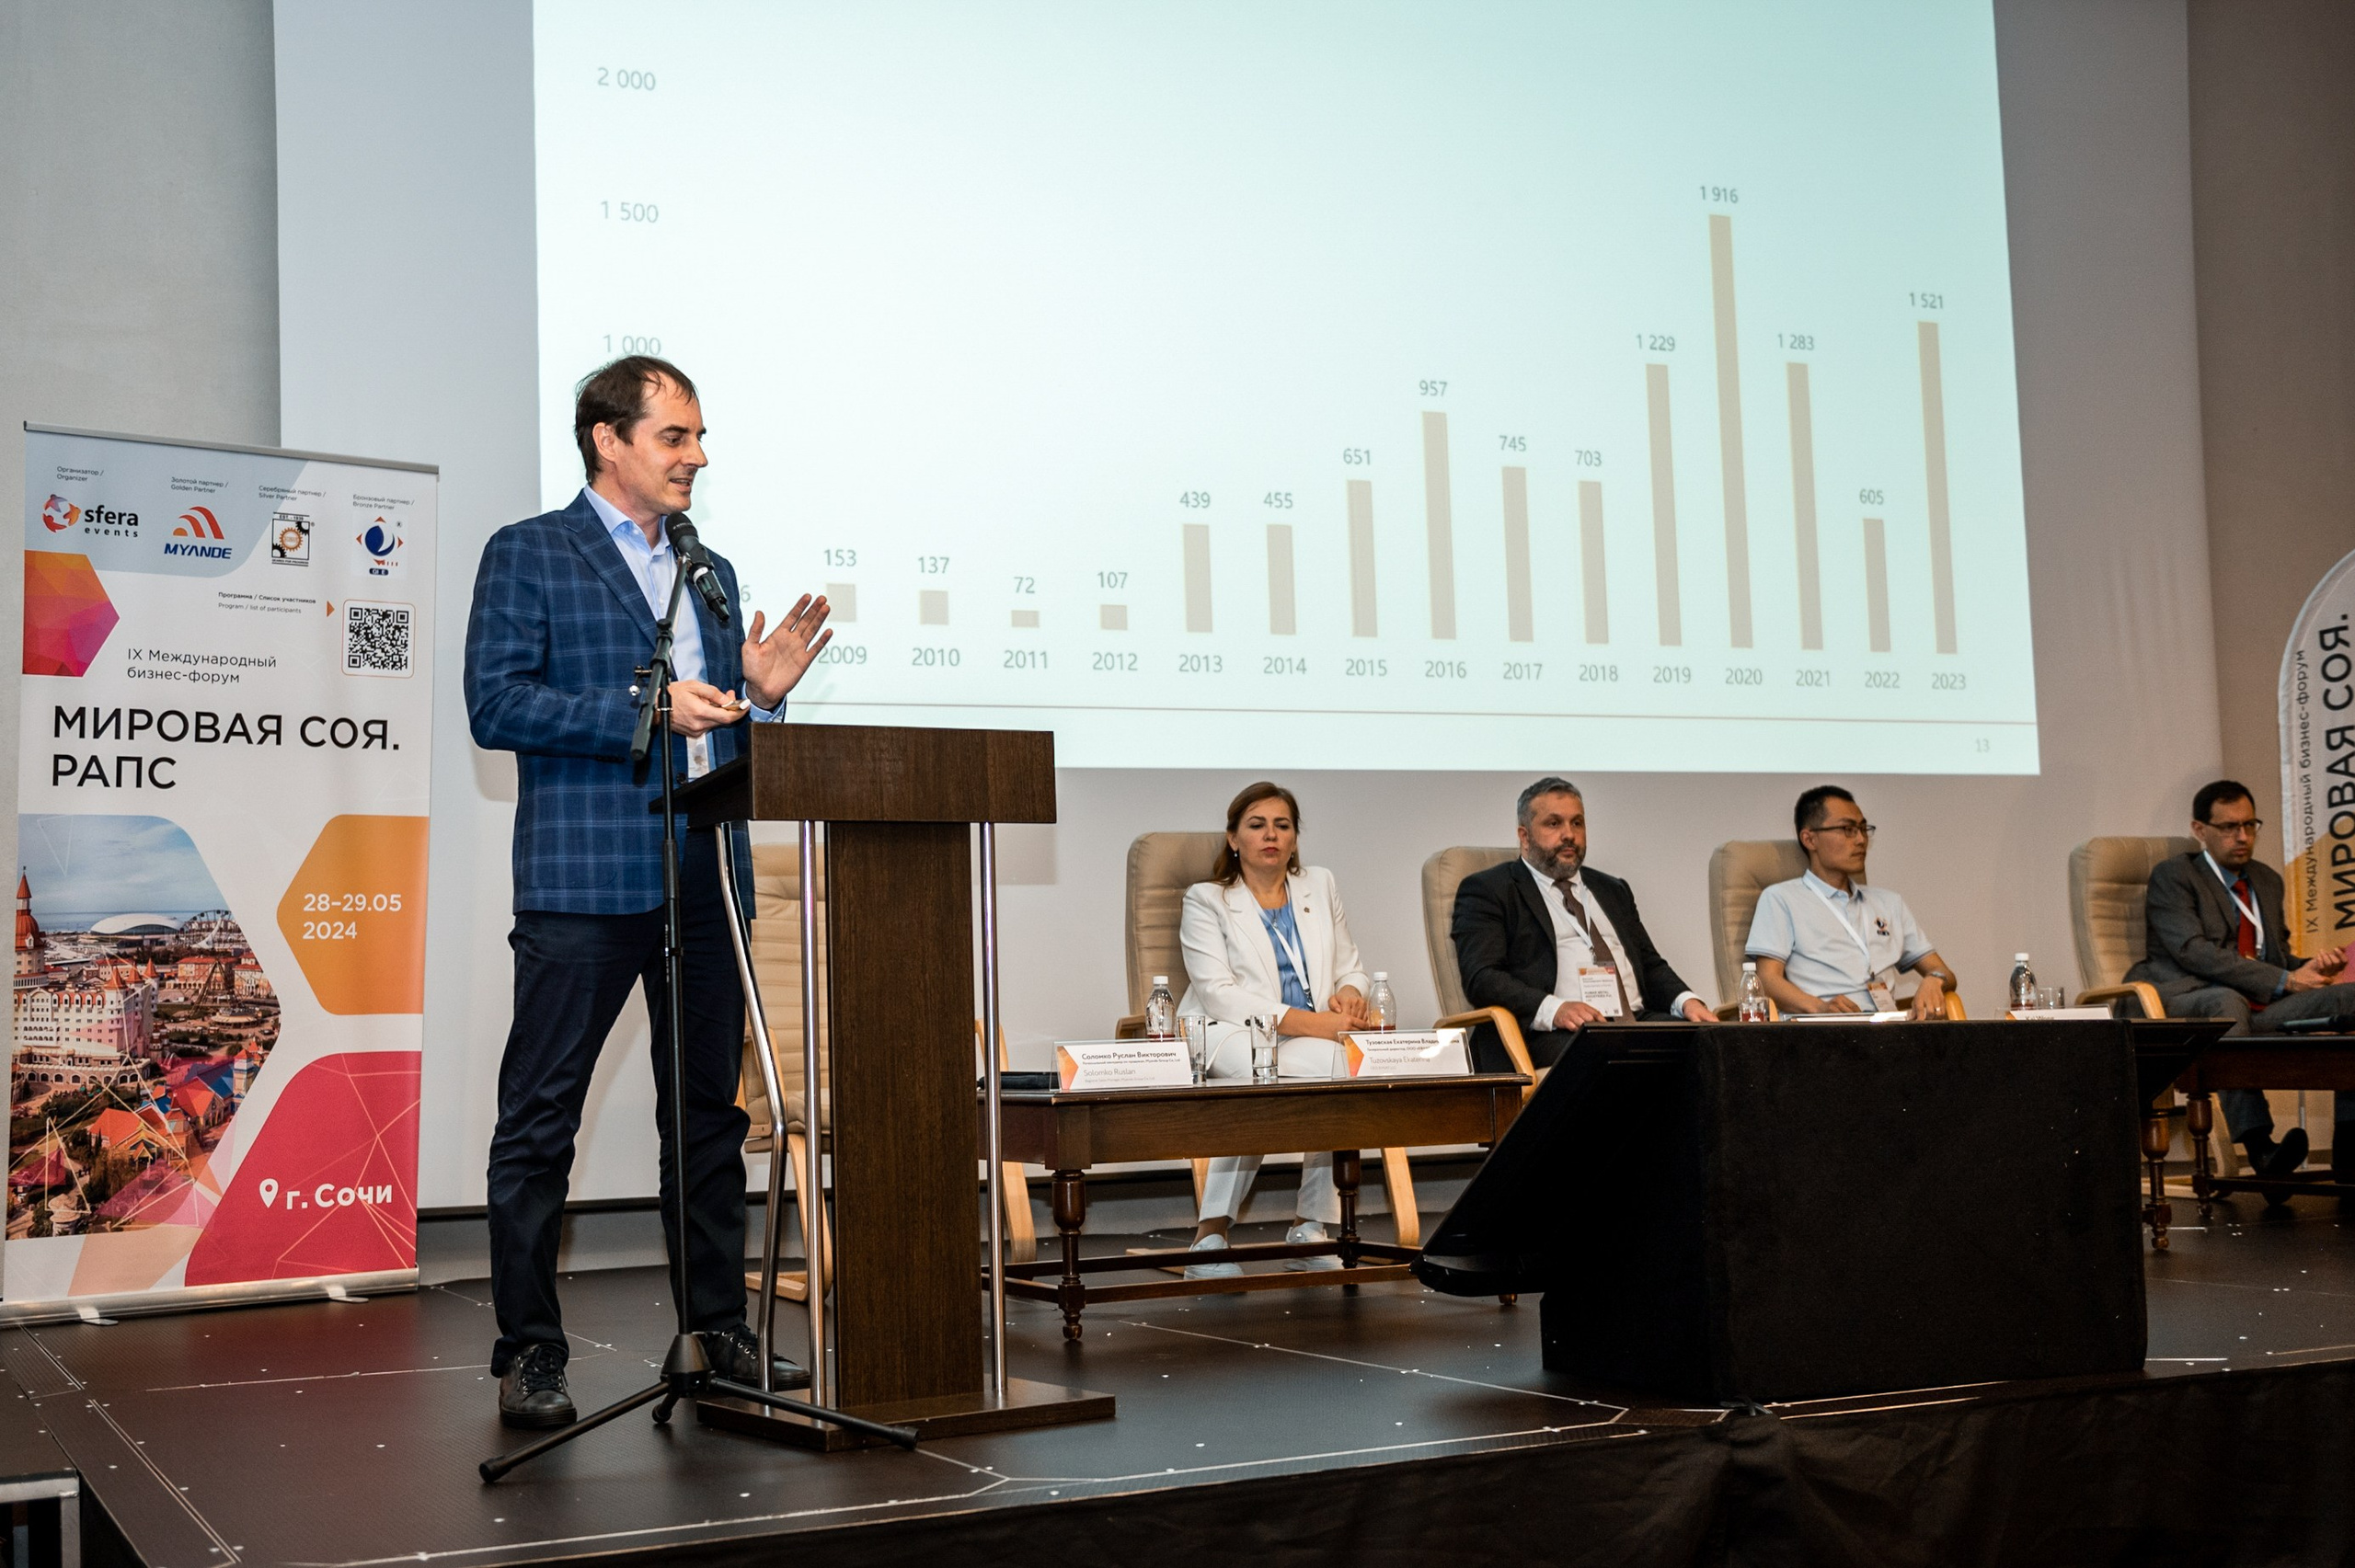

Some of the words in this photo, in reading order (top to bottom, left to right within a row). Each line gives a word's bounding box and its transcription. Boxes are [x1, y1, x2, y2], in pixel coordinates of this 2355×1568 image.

[617, 69, 656, 91] 000
[621, 201, 659, 223] 500
[622, 336, 661, 356] 000
[1419, 380, 1448, 396] 957
[1499, 435, 1526, 452] 745
[1343, 448, 1371, 465] 651
[1575, 450, 1603, 467] 703
[171, 476, 197, 485] Золотой
[1179, 491, 1211, 509] 439
[1263, 492, 1293, 509] 455
[1859, 488, 1884, 505] 605
[85, 505, 138, 526] sfera
[85, 527, 138, 538] events
[164, 544, 232, 559] MYANDE
[824, 549, 856, 567] 153
[918, 556, 949, 574] 137
[1014, 577, 1035, 594] 72
[1097, 571, 1128, 589] 107
[218, 591, 253, 600] Программа
[258, 594, 281, 602] Список
[218, 602, 245, 611] Program
[149, 649, 276, 667] Международный
[2319, 613, 2353, 711] СОЯ.
[127, 667, 240, 684] бизнес-форум
[818, 646, 867, 664] 2009
[912, 647, 960, 667] 2010
[1004, 649, 1047, 669] 2011
[1093, 652, 1138, 671] 2012
[1179, 654, 1223, 672] 2013
[1264, 657, 1307, 674] 2014
[1346, 658, 1387, 677] 2015
[1425, 660, 1467, 679] 2016
[1503, 662, 1543, 680] 2017
[1580, 664, 1618, 681] 2018
[1653, 666, 1691, 683] 2019
[1726, 668, 1763, 685] 2020
[1796, 670, 1830, 687] 2021
[1865, 671, 1900, 689] 2022
[1932, 672, 1966, 690] 2023
[2296, 650, 2312, 769] бизнес-форум
[54, 705, 281, 745] МИРОВАЯ
[300, 716, 398, 750] СОЯ.
[1976, 738, 1990, 752] 13
[52, 754, 176, 789] РАПС
[2301, 773, 2317, 912] Международный
[304, 894, 401, 911] 28-29.05
[303, 921, 357, 939] 2024
[1114, 1068, 1136, 1076] Ruslan
[286, 1190, 307, 1209] г.
[315, 1184, 393, 1207] Сочи
